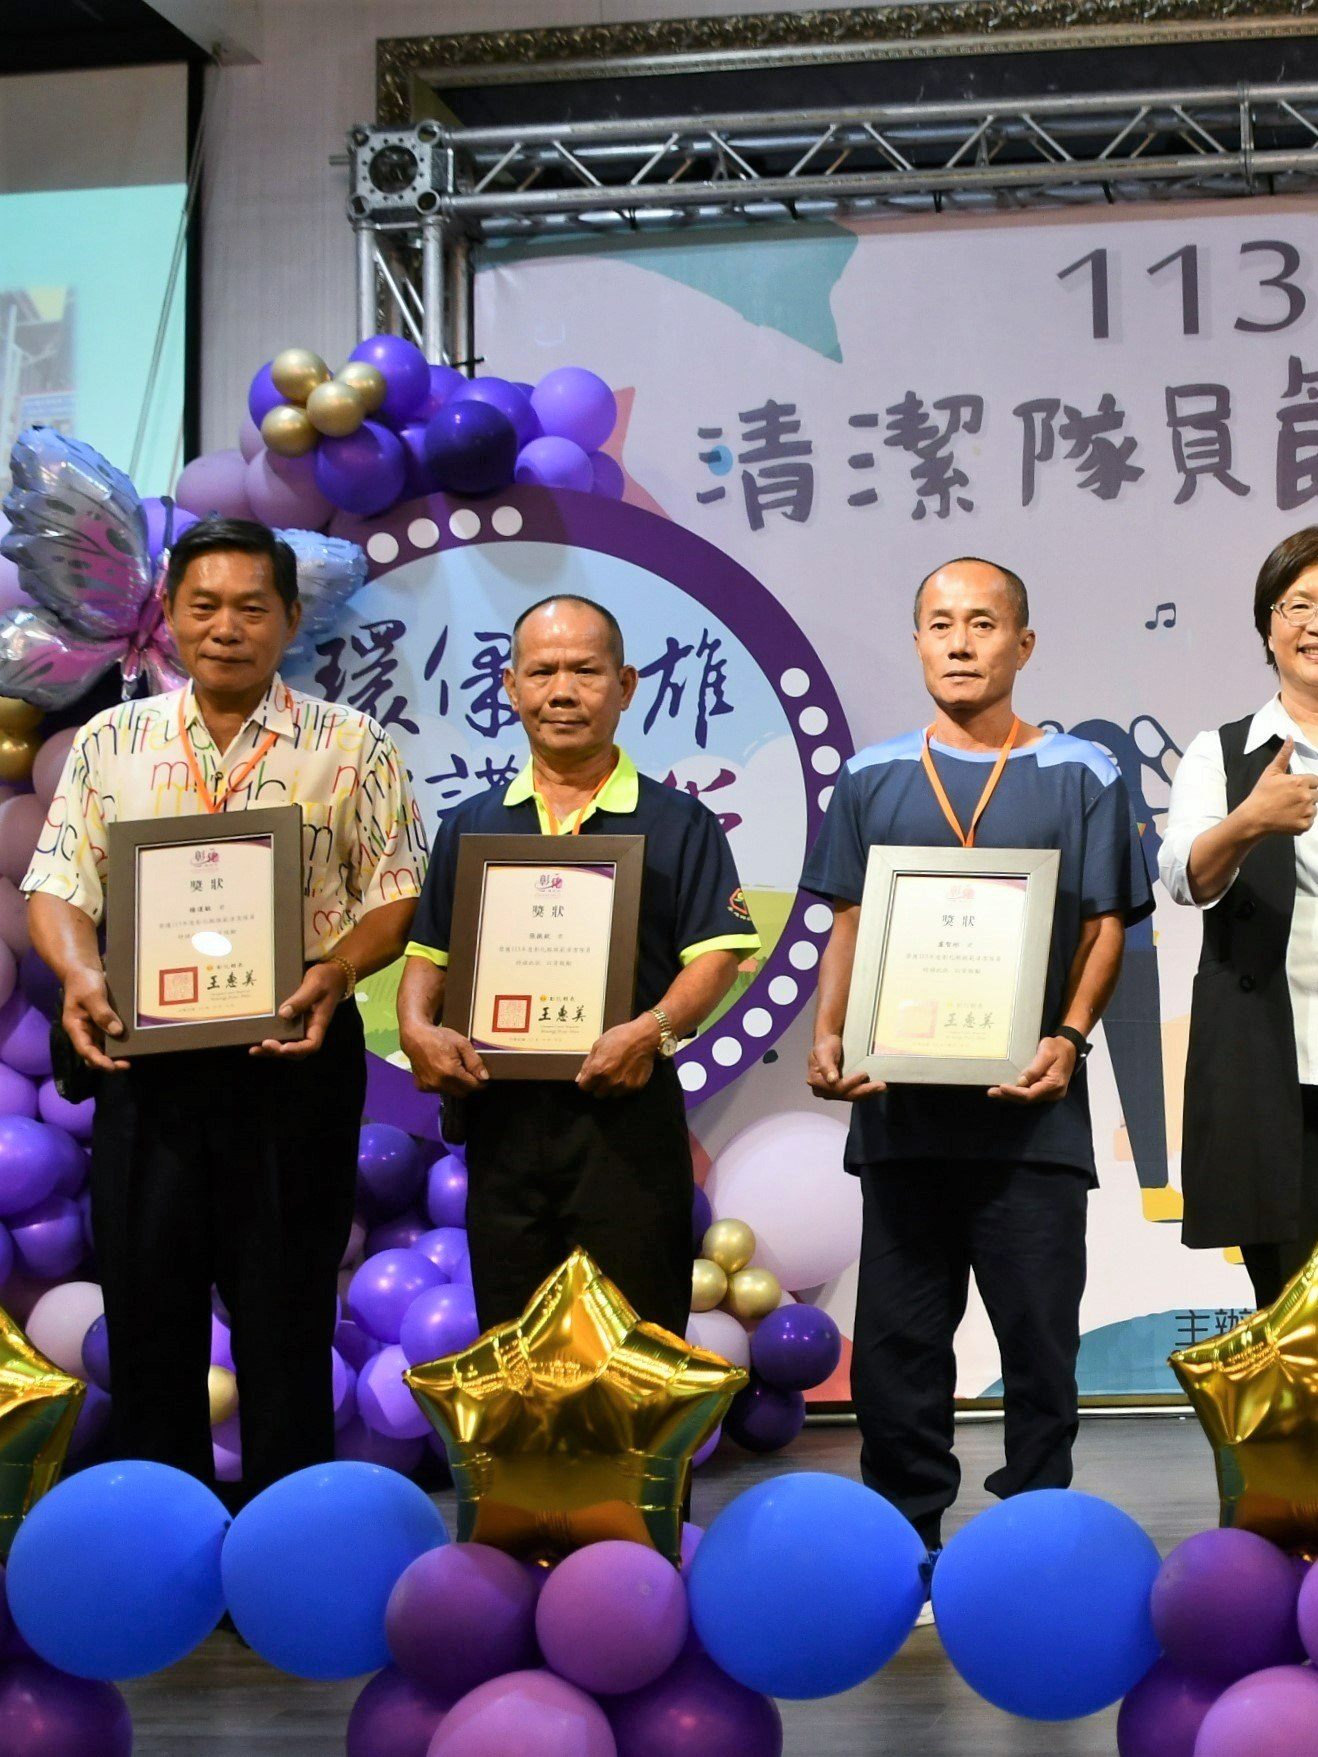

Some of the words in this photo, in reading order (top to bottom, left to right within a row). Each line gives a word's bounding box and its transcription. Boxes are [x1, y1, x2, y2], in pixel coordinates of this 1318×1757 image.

[316, 619, 735, 749] 環保雄
[538, 1004, 587, 1022] 王惠美
